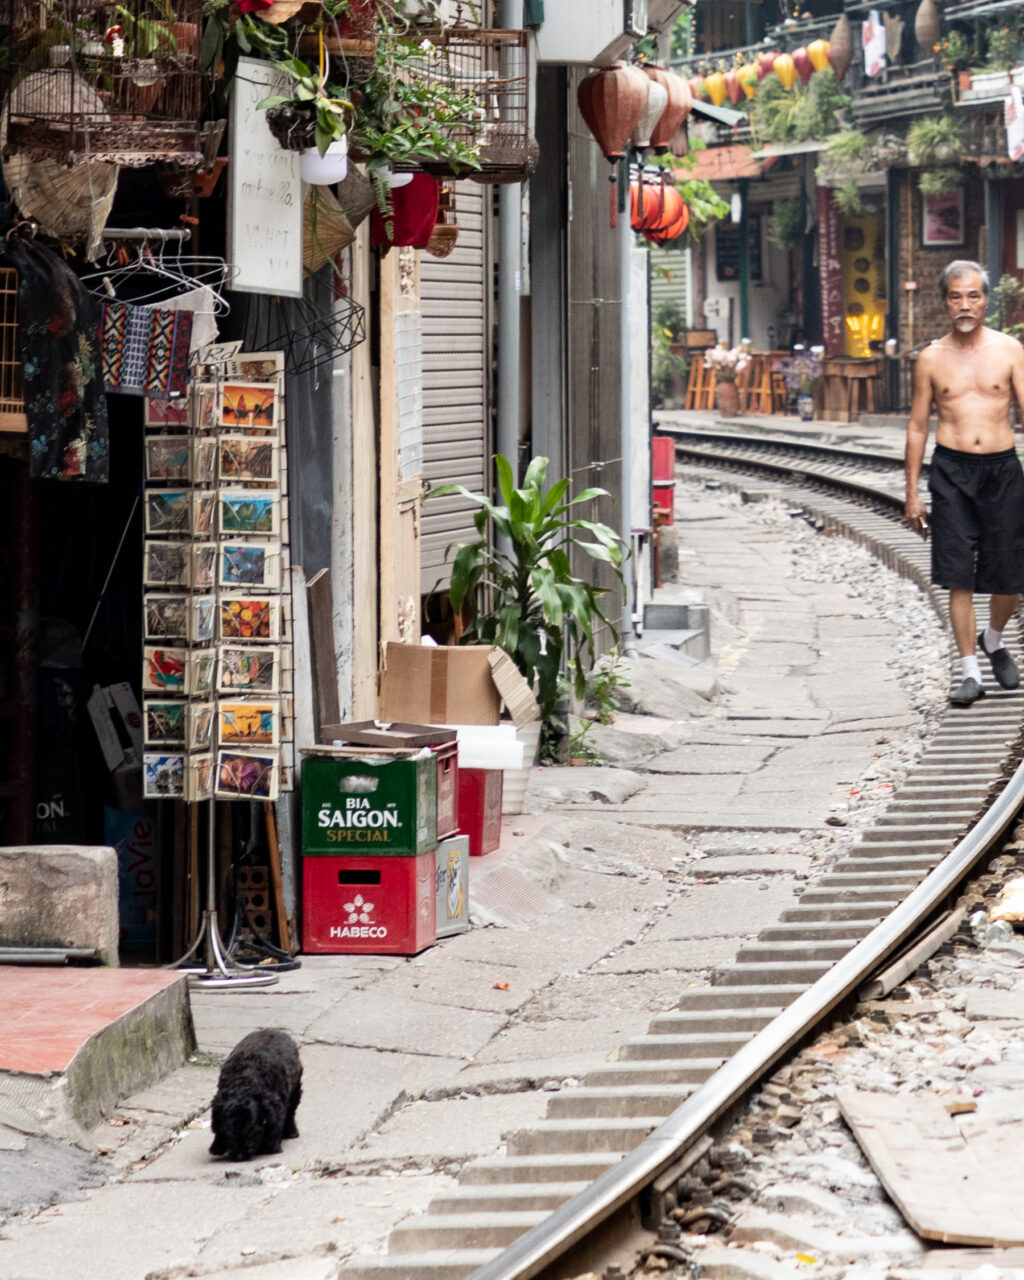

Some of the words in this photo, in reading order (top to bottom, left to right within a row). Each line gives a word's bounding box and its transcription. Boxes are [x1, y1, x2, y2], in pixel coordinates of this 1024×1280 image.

[346, 798, 371, 809] BIA
[326, 829, 392, 842] SPECIAL
[330, 926, 388, 938] HABECO
